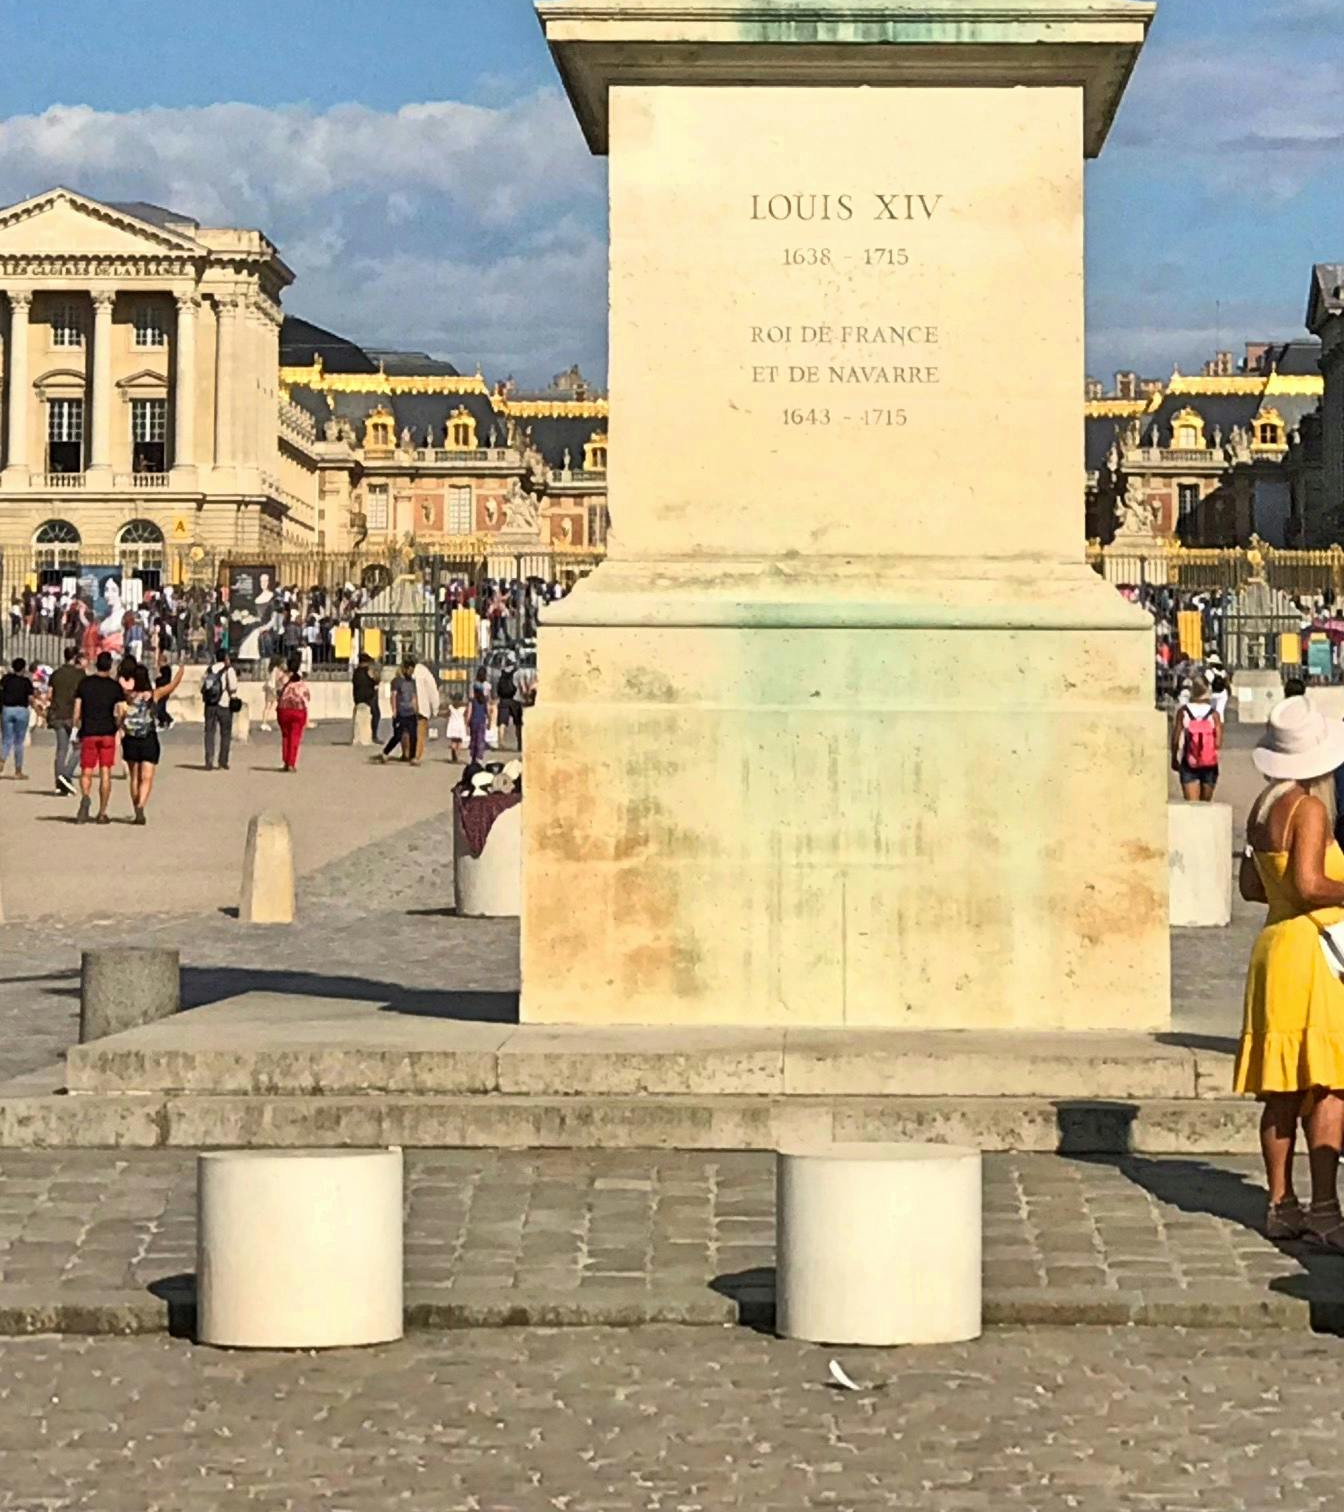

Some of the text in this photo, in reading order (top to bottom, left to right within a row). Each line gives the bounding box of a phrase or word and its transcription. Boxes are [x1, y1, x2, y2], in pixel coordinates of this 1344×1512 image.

[750, 193, 944, 221] LOUIS XIV
[782, 247, 832, 266] 1638
[863, 247, 910, 266] 1715
[751, 326, 939, 345] ROI DE FRANCE
[752, 366, 940, 383] ET DE NAVARRE
[782, 409, 831, 426] 1643
[863, 409, 908, 426] 1715
[175, 520, 185, 532] A
